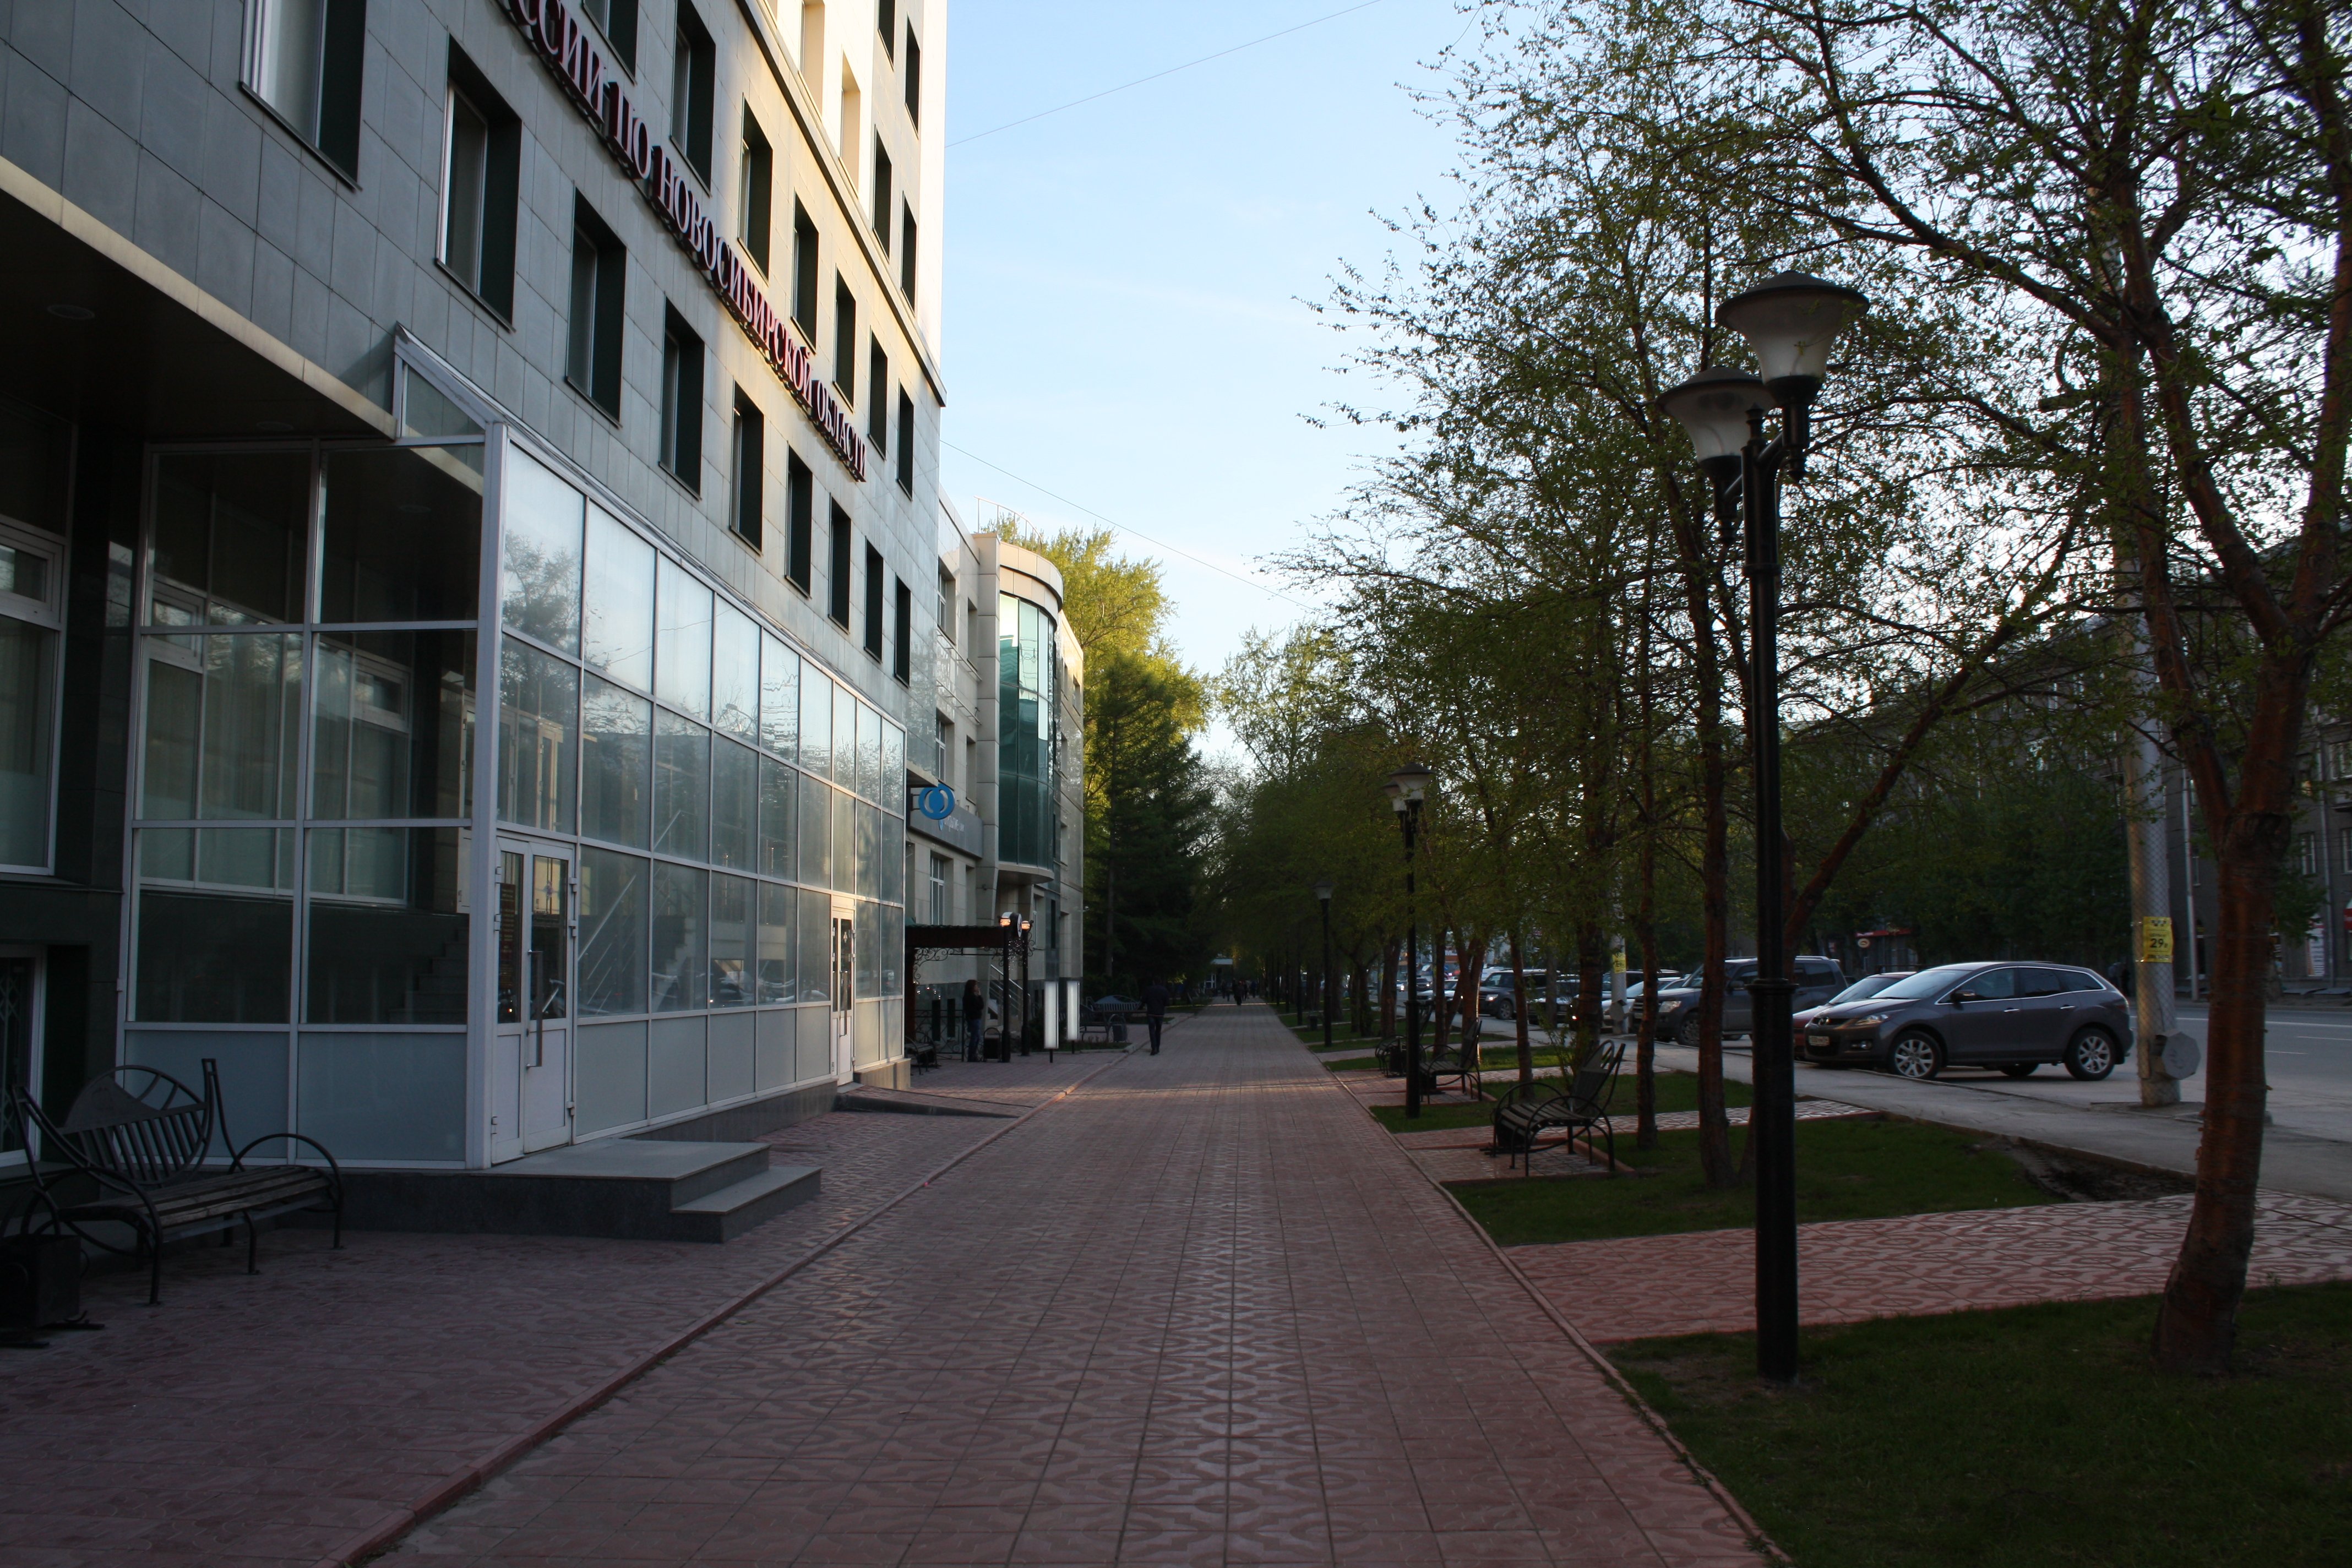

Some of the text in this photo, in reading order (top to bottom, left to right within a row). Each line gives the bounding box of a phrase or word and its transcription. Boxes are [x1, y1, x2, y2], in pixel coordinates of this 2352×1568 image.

[613, 83, 652, 179] ПО
[657, 146, 813, 406] НОВОСИБИРСКОЙ
[815, 380, 866, 481] ОБЛАСТИ
